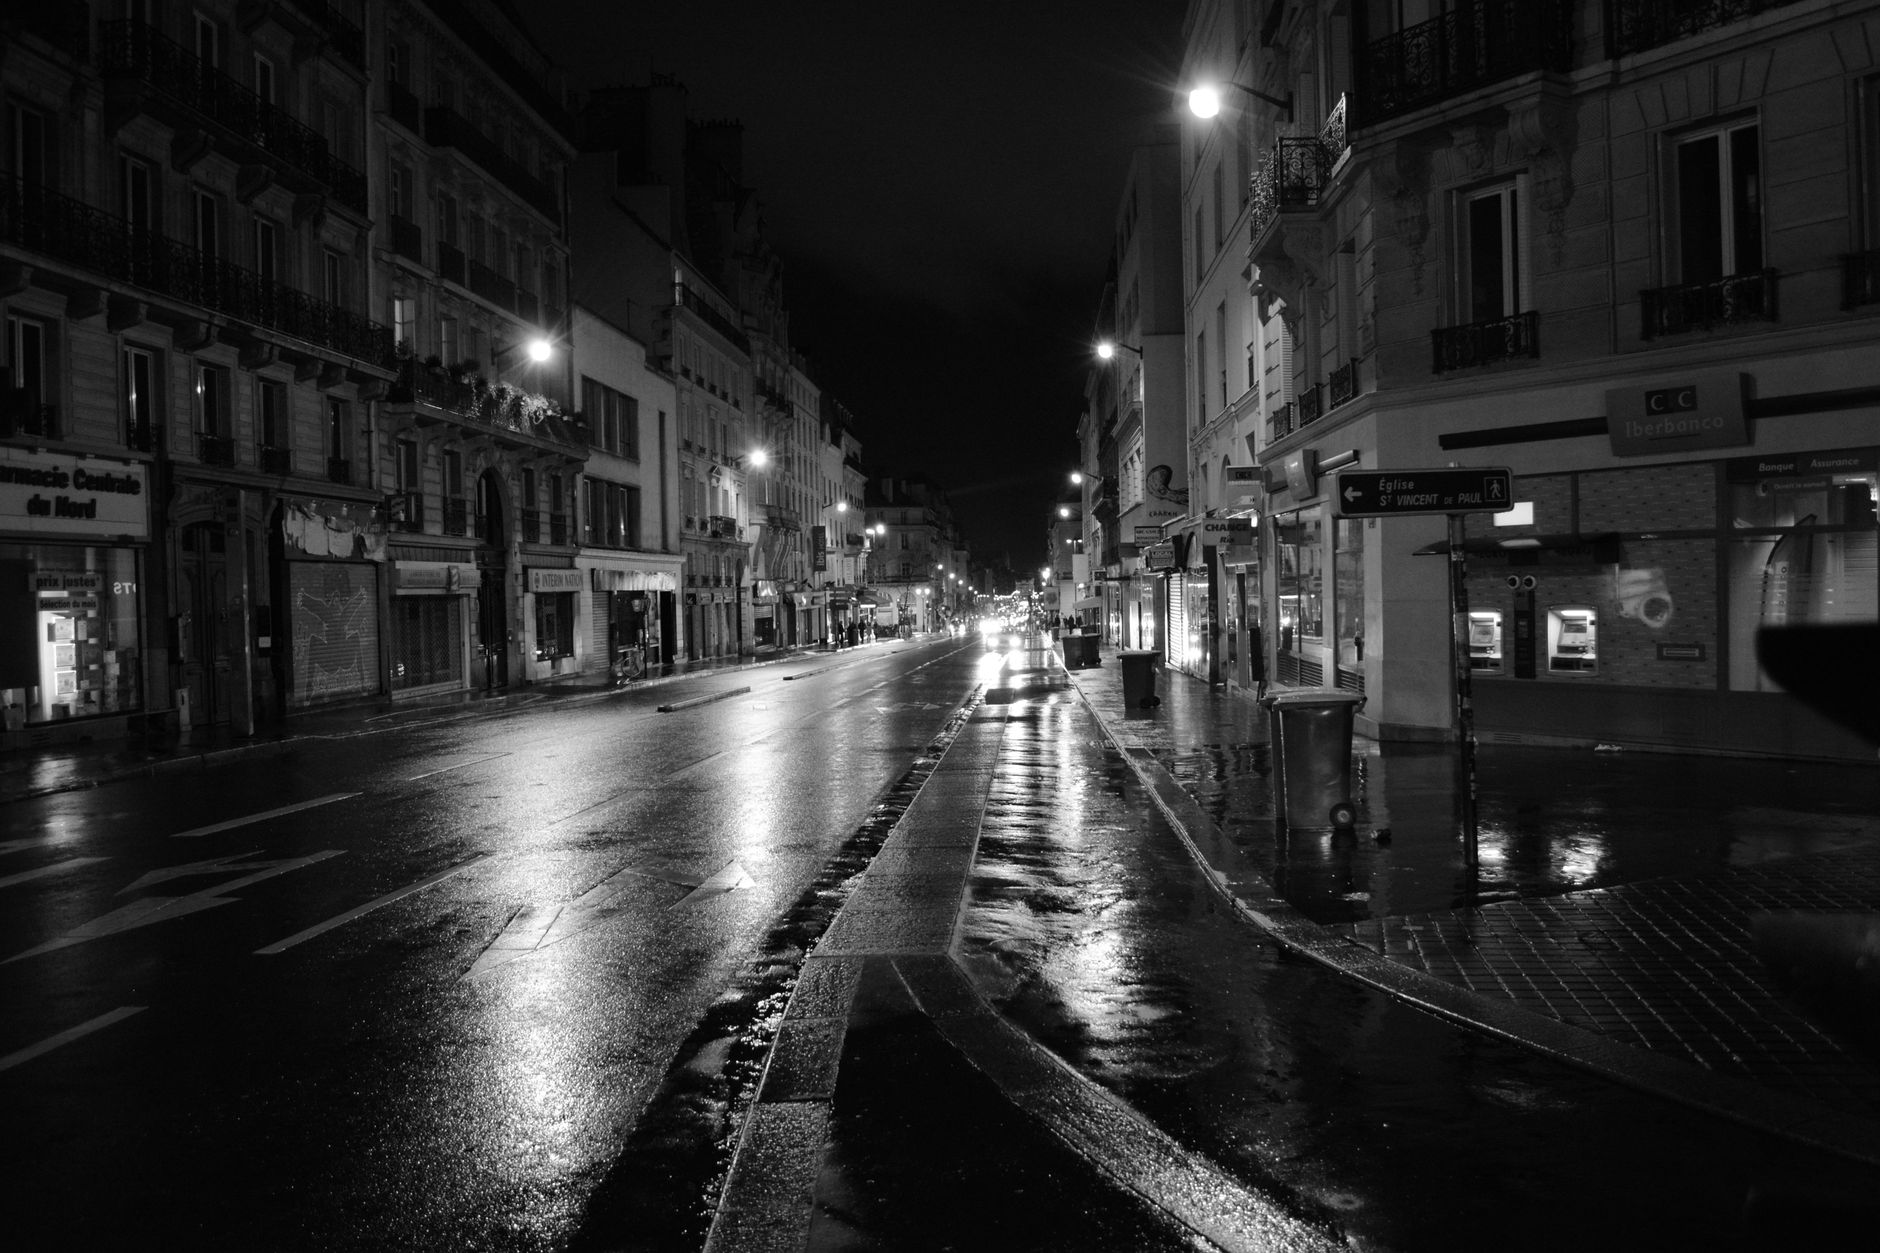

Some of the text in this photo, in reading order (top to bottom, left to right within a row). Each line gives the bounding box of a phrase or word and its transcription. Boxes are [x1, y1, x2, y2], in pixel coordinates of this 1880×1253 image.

[1625, 416, 1724, 438] Iberbanco
[1758, 458, 1860, 473] Banque Assurance
[73, 468, 141, 495] Centrale
[1379, 477, 1415, 493] Église
[27, 494, 96, 518] du Nord
[1396, 494, 1439, 506] VINCENT
[1457, 492, 1483, 504] PAUL
[1205, 523, 1249, 532] CHANGE
[36, 575, 59, 590] prix
[40, 600, 96, 609] Sélection du mois
